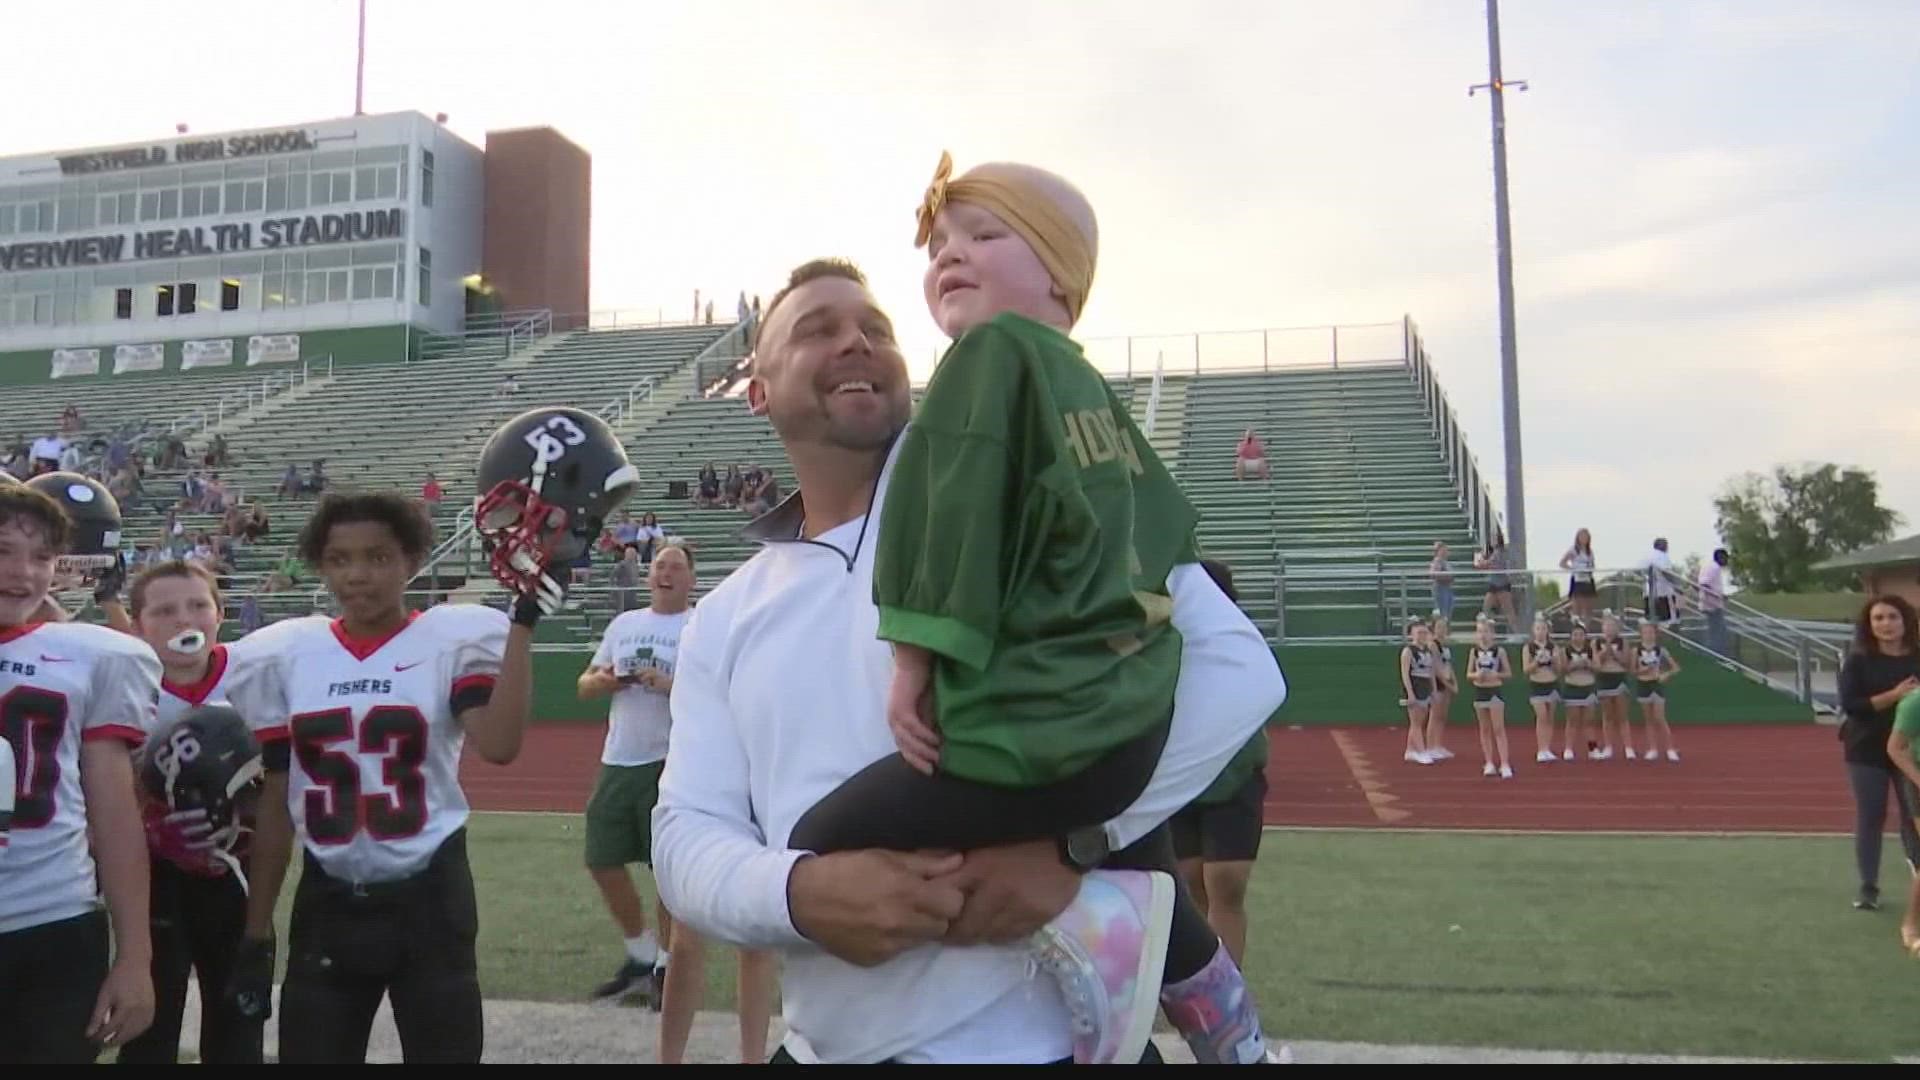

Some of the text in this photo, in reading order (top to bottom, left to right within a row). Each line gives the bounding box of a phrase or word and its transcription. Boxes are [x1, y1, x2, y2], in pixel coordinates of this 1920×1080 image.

[58, 128, 315, 175] WESTFIELD HIGH SCHOOL
[134, 221, 252, 258] HEALTH
[261, 207, 402, 248] STADIUM
[524, 415, 587, 463] 53
[328, 679, 392, 697] FISHERS
[291, 704, 429, 846] 53
